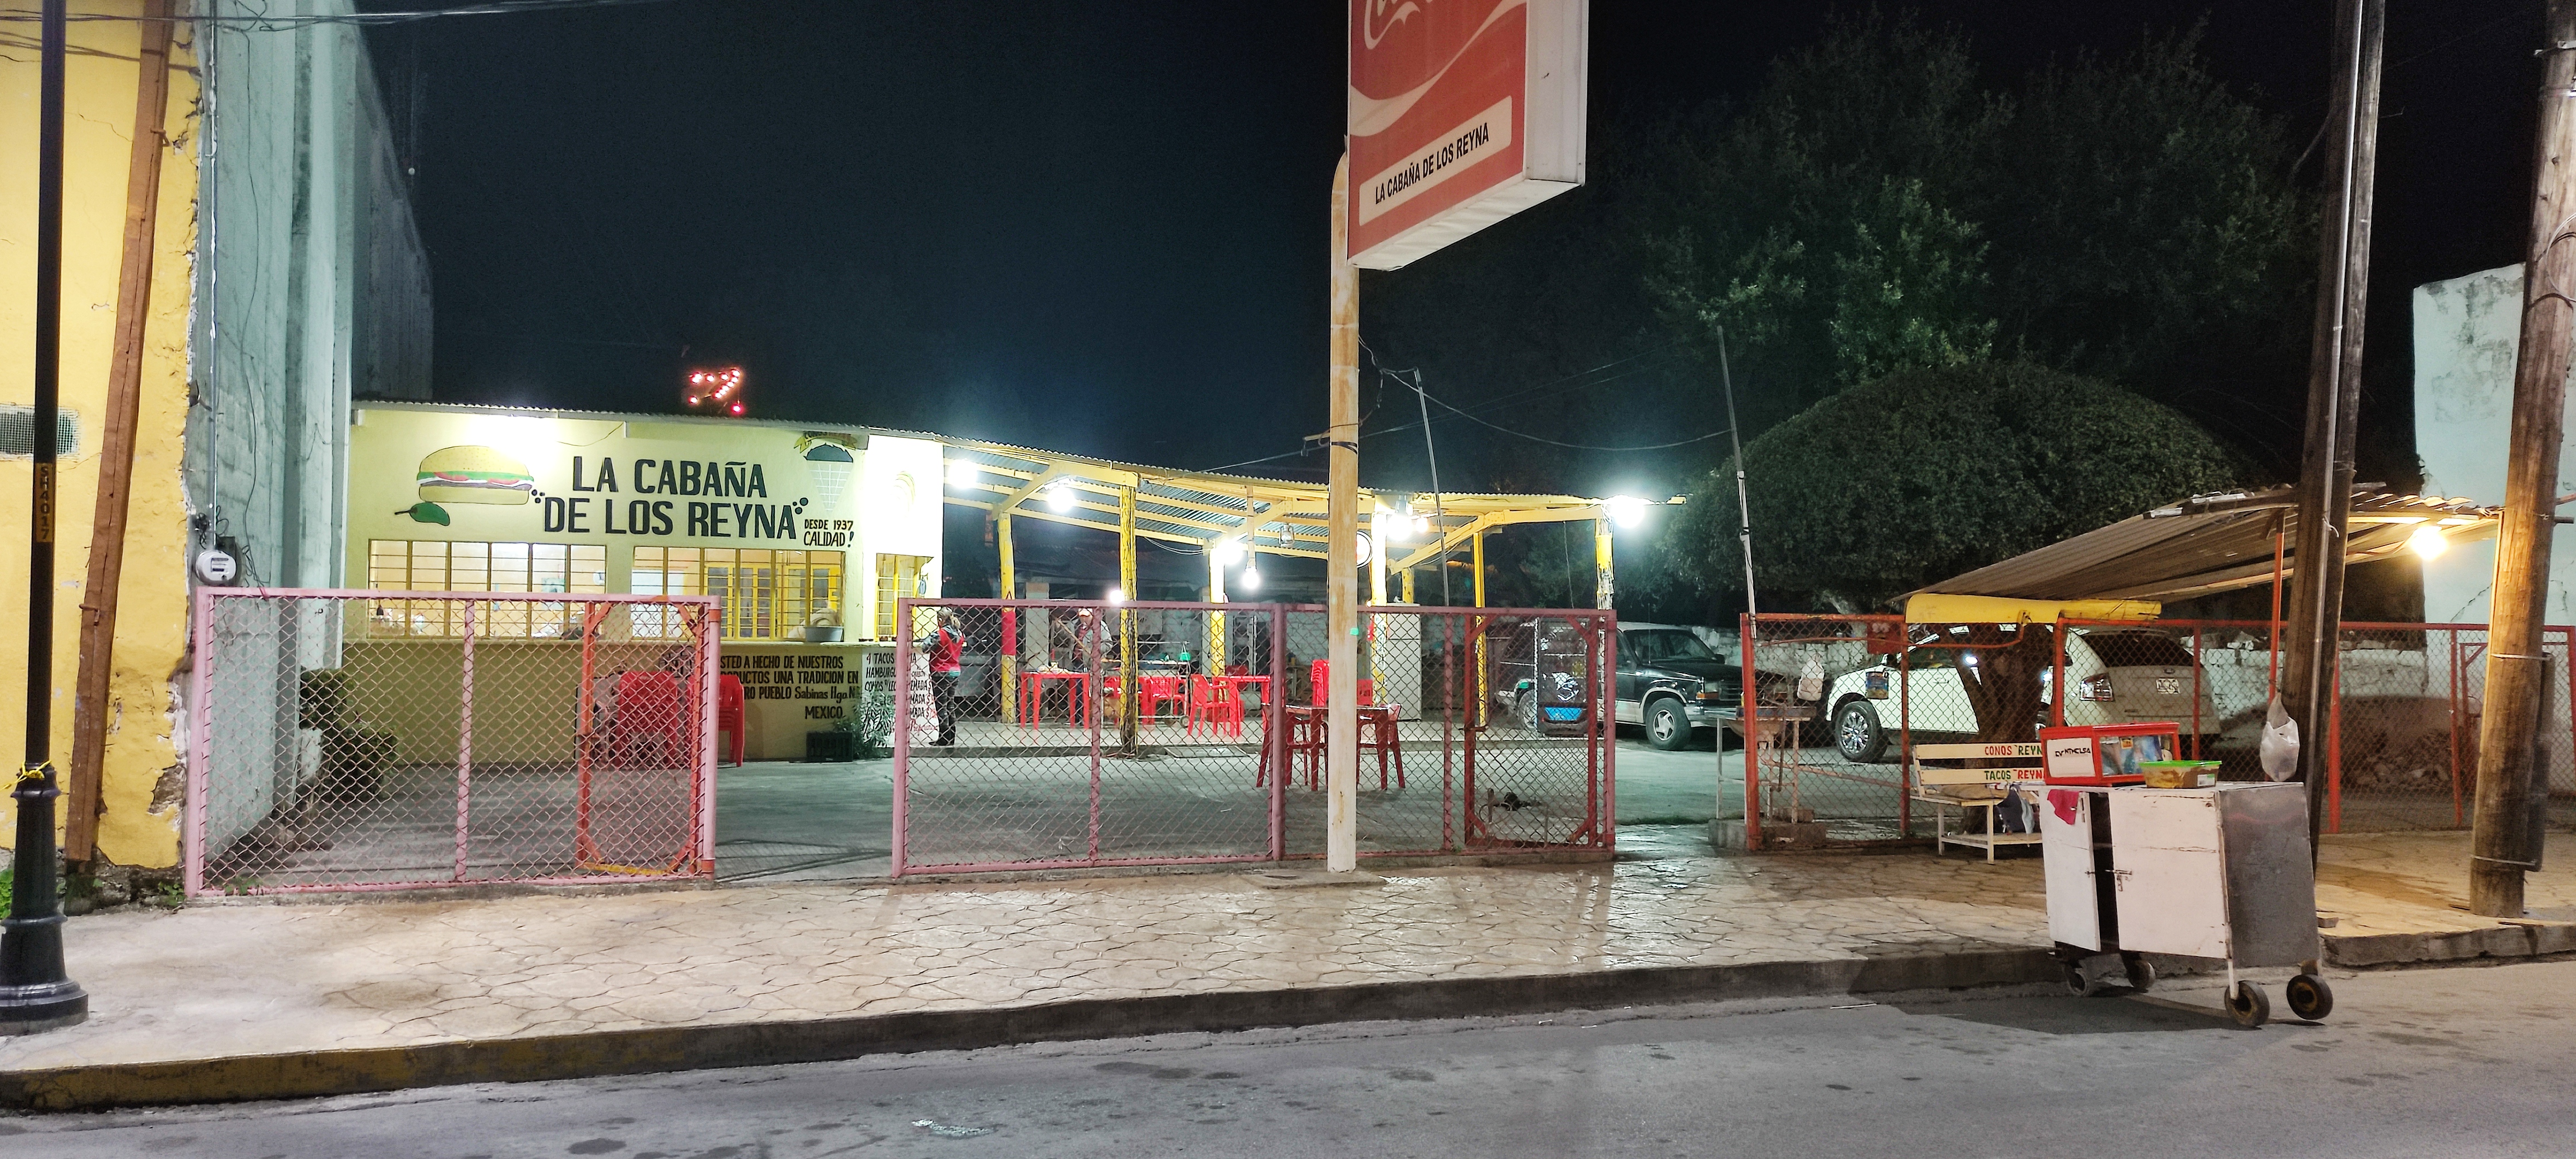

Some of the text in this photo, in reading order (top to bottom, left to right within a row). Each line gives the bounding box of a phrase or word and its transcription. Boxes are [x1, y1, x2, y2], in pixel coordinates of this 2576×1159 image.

[1375, 122, 1489, 204] LA CABAÑA DE LOS REYNA
[573, 456, 767, 498] LA CABAÑA
[544, 497, 797, 539] DE LOS REYNA
[804, 519, 853, 531] DESDE 1937
[720, 656, 843, 669] STED A HECHO DE NUESTROS
[874, 652, 895, 664] TACOS
[774, 671, 794, 684] UNA
[797, 671, 844, 684] TRADICION
[847, 671, 859, 684] EN
[759, 686, 792, 699] PUEBLO
[794, 686, 828, 699] Sabinas
[1984, 746, 2012, 756] CONOS
[1984, 770, 2011, 780] TACOS
